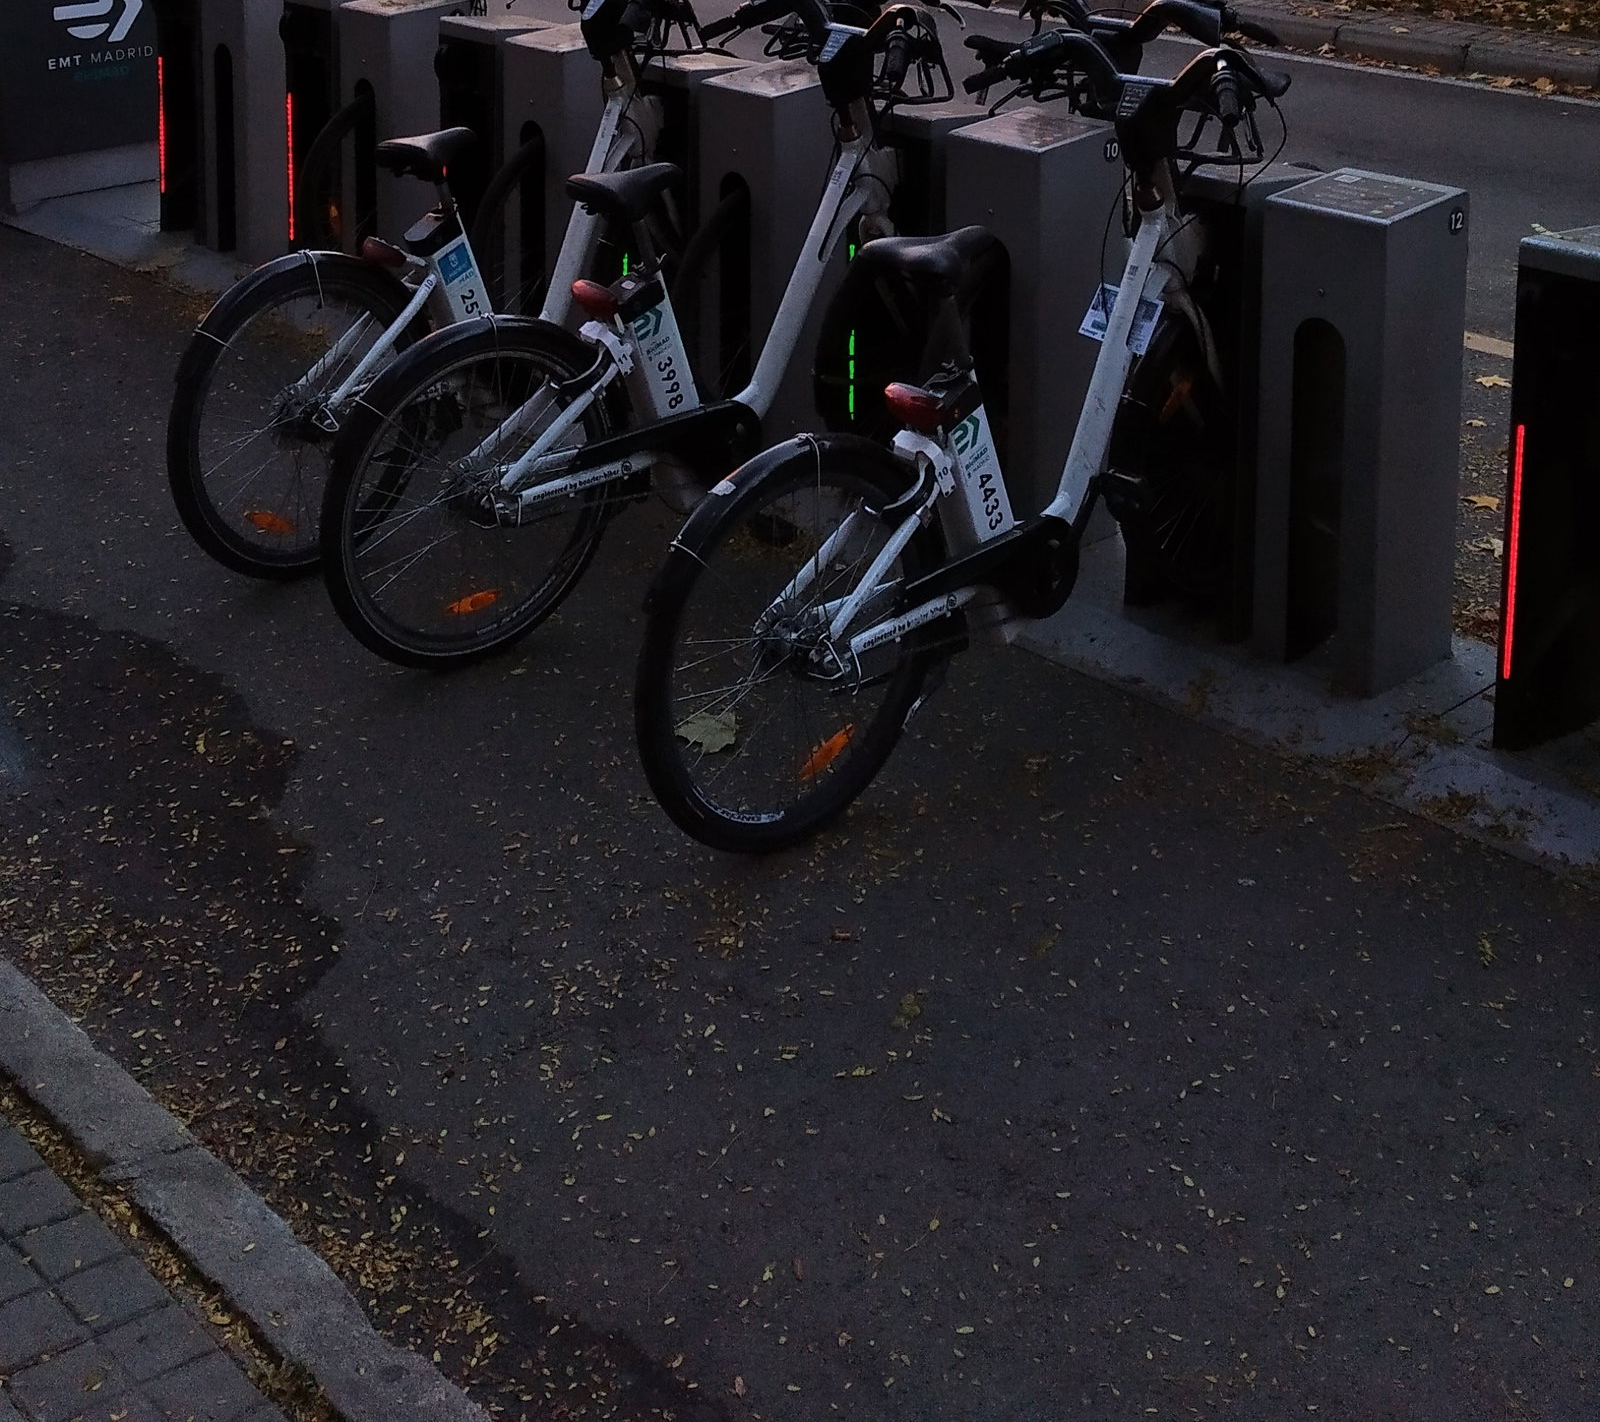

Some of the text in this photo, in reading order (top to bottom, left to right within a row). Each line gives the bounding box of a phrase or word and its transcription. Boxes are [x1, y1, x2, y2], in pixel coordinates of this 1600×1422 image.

[48, 46, 153, 70] EMT MADRID
[1105, 142, 1119, 158] 10
[1450, 212, 1463, 230] 12
[460, 289, 481, 316] 25
[657, 356, 684, 409] 3998
[938, 466, 949, 480] 10
[978, 473, 1003, 531] 4433
